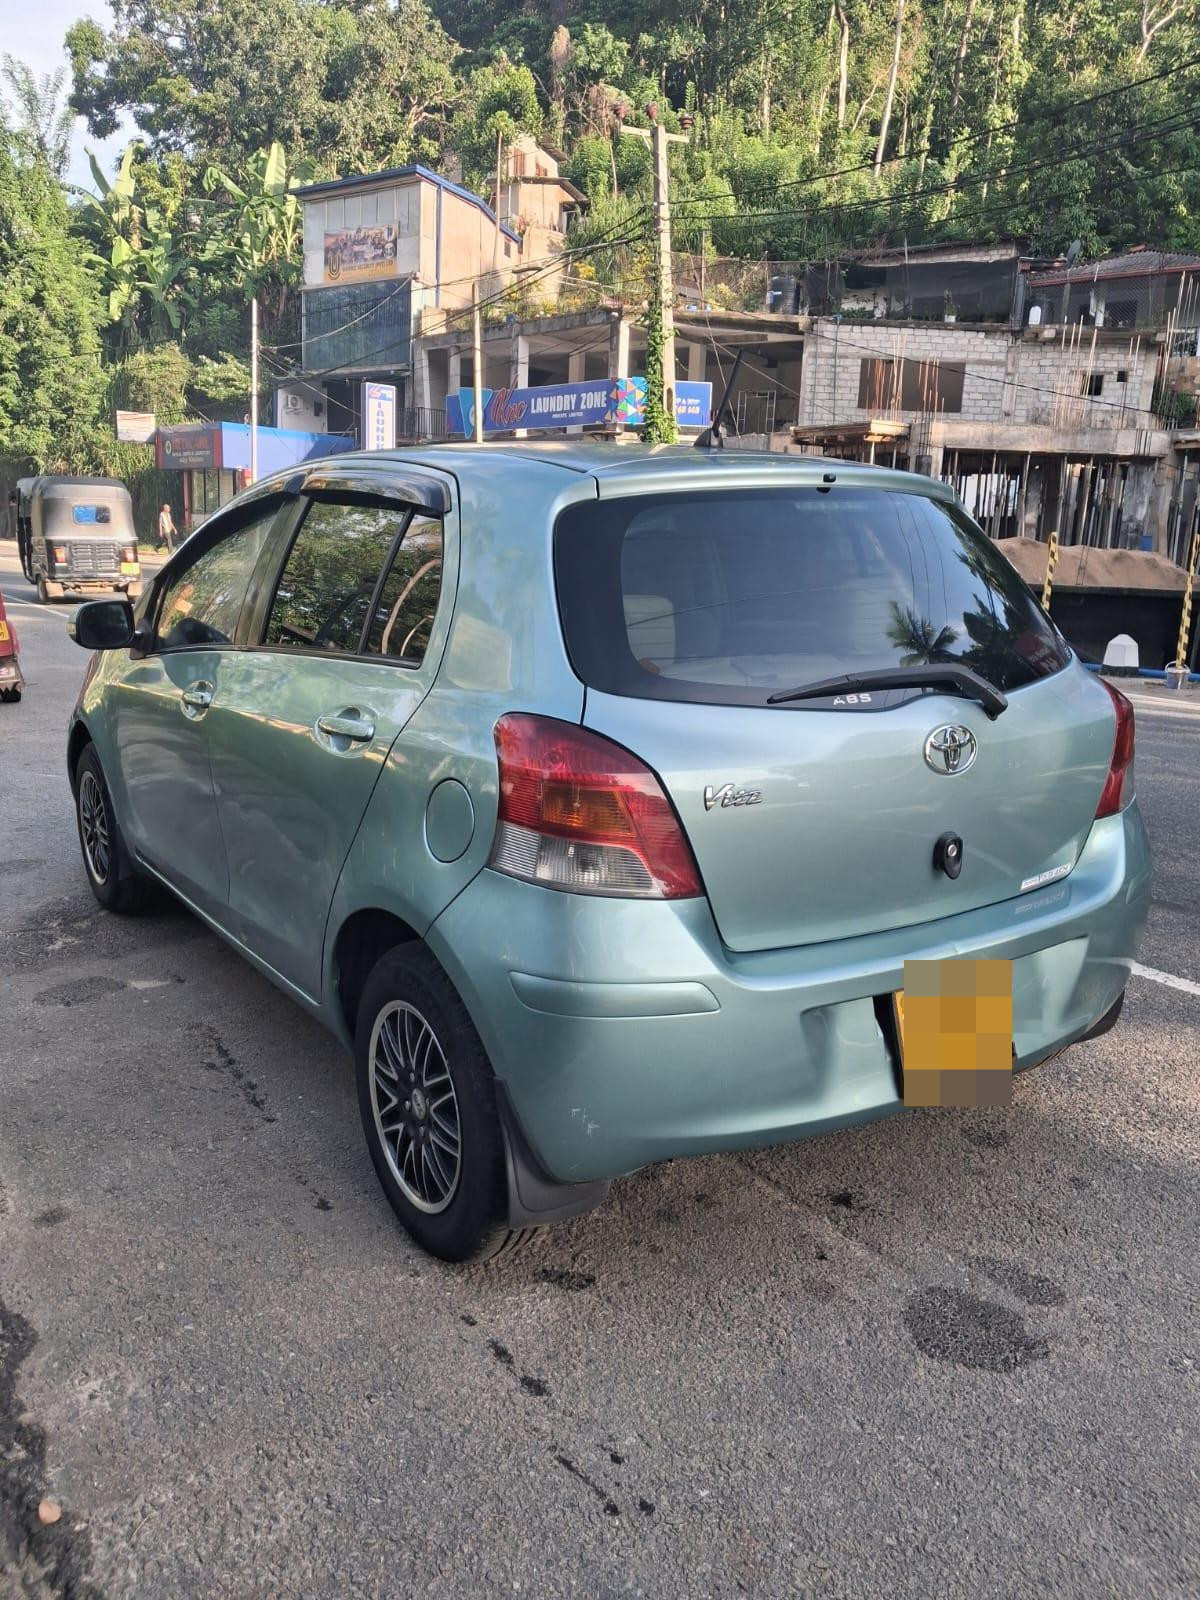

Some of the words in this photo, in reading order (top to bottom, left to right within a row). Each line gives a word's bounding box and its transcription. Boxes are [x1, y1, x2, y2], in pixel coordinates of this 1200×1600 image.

[530, 394, 577, 414] LAUNDRY
[580, 391, 607, 409] ZONE
[832, 693, 872, 706] ABS
[703, 783, 763, 811] Vitz
